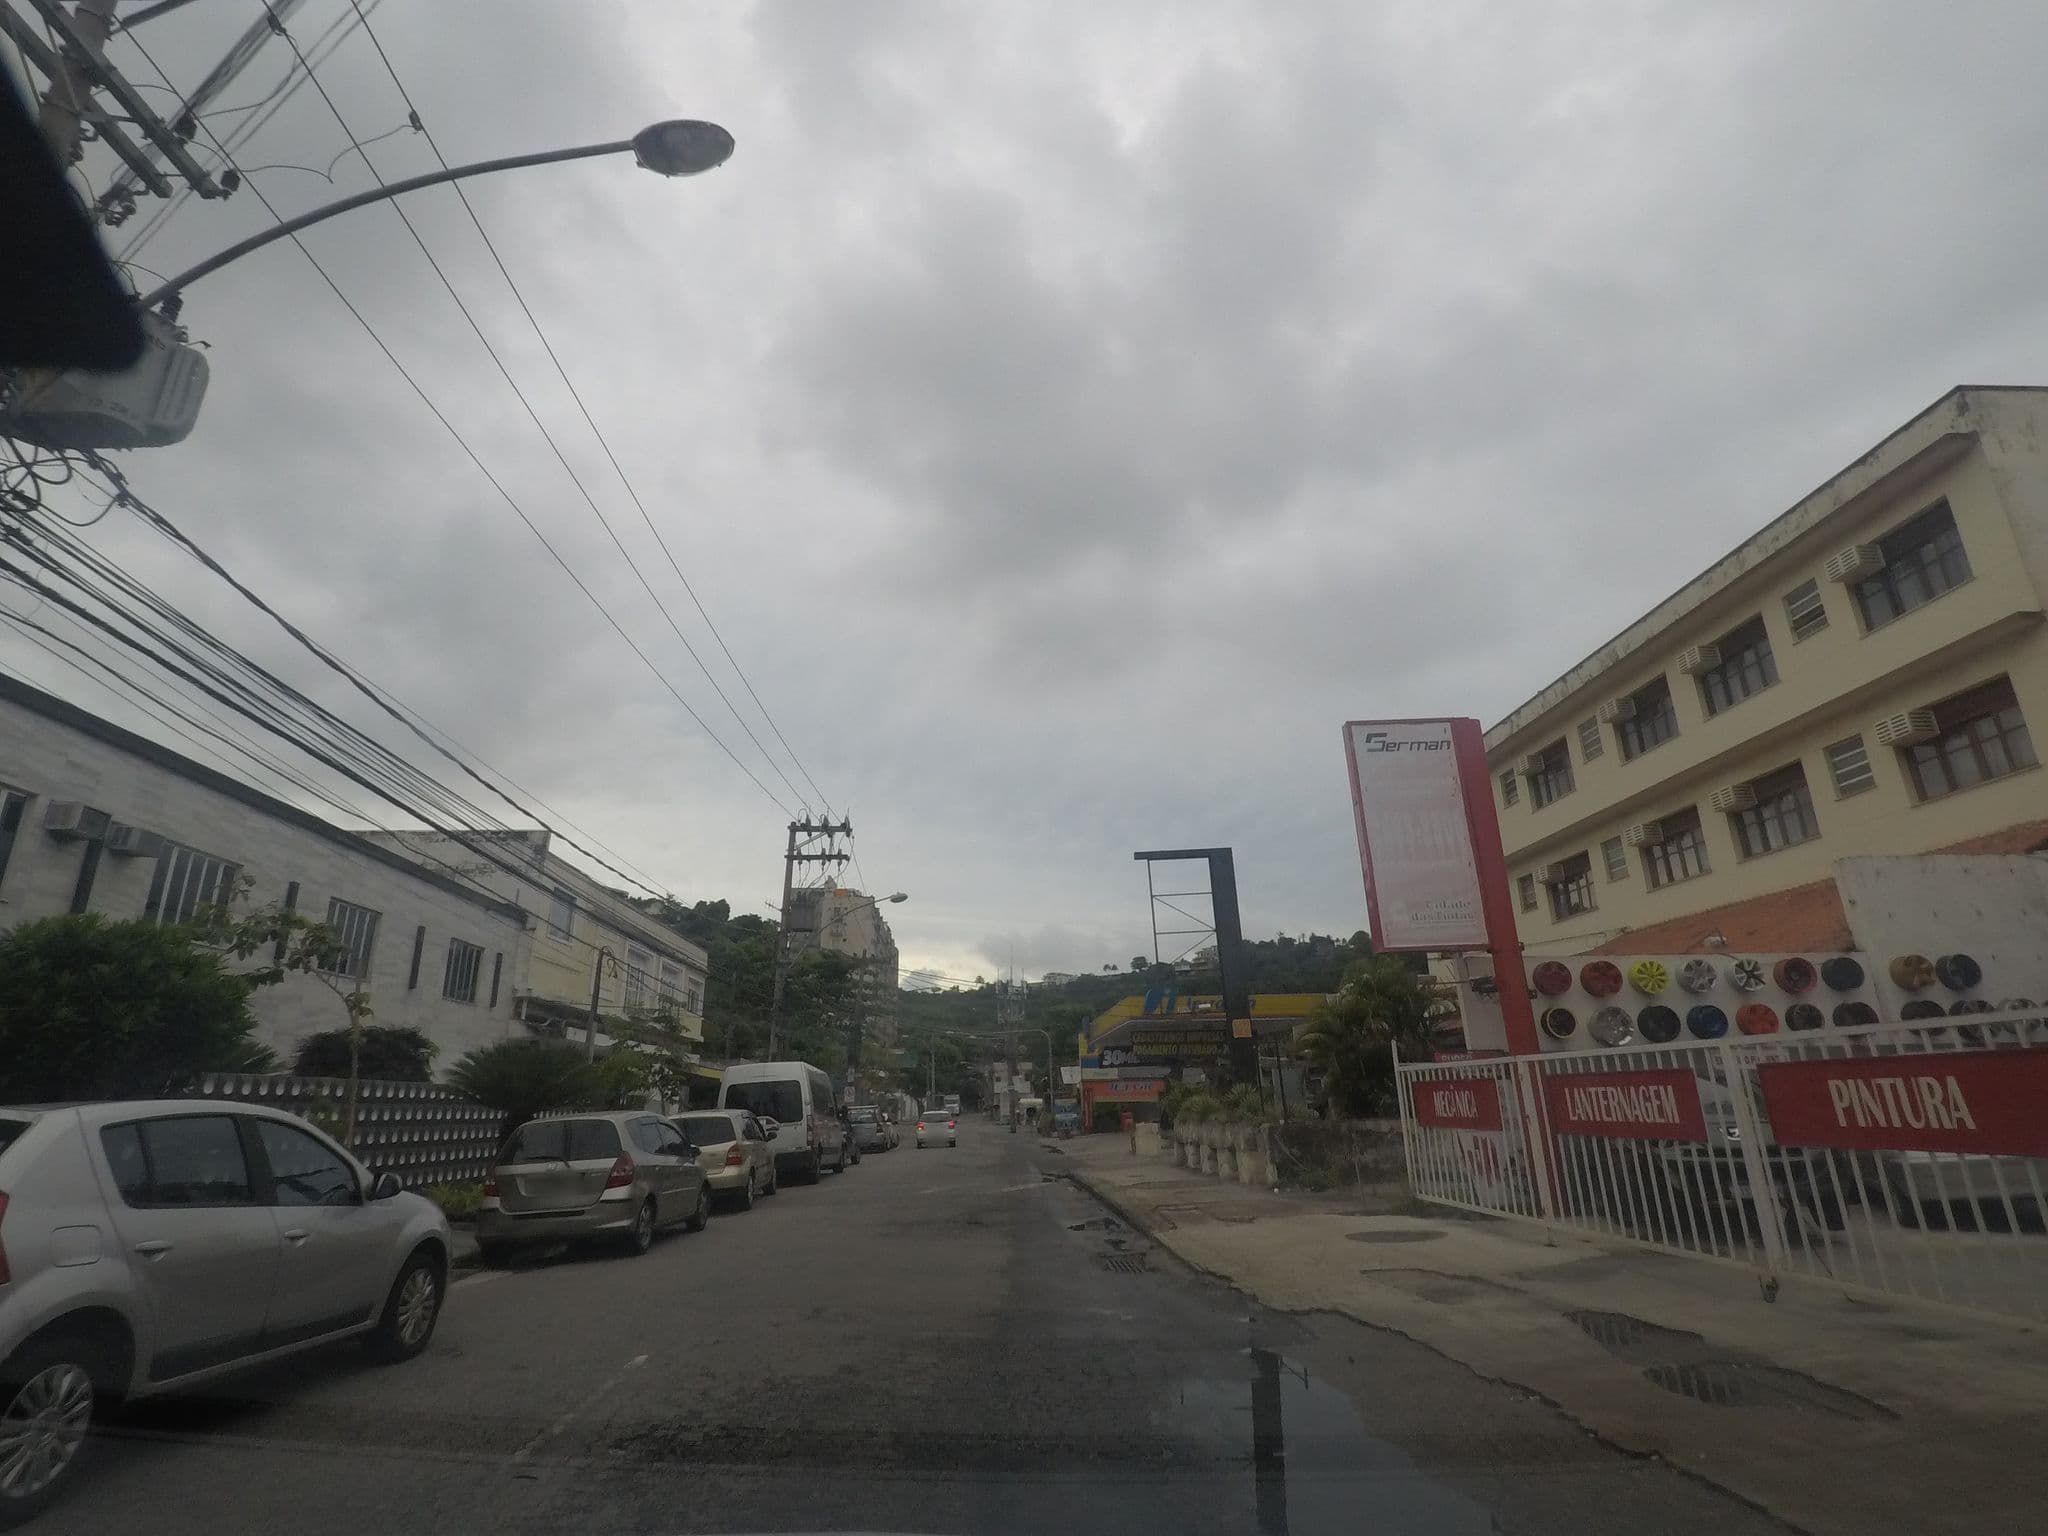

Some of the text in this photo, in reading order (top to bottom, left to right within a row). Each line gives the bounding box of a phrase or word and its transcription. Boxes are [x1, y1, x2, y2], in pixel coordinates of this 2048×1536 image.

[1365, 733, 1451, 752] Serman
[1433, 1084, 1479, 1119] MECÂNICA
[1564, 1085, 1680, 1124] LANTERNAGEM
[1827, 1075, 1977, 1130] PINTURA
